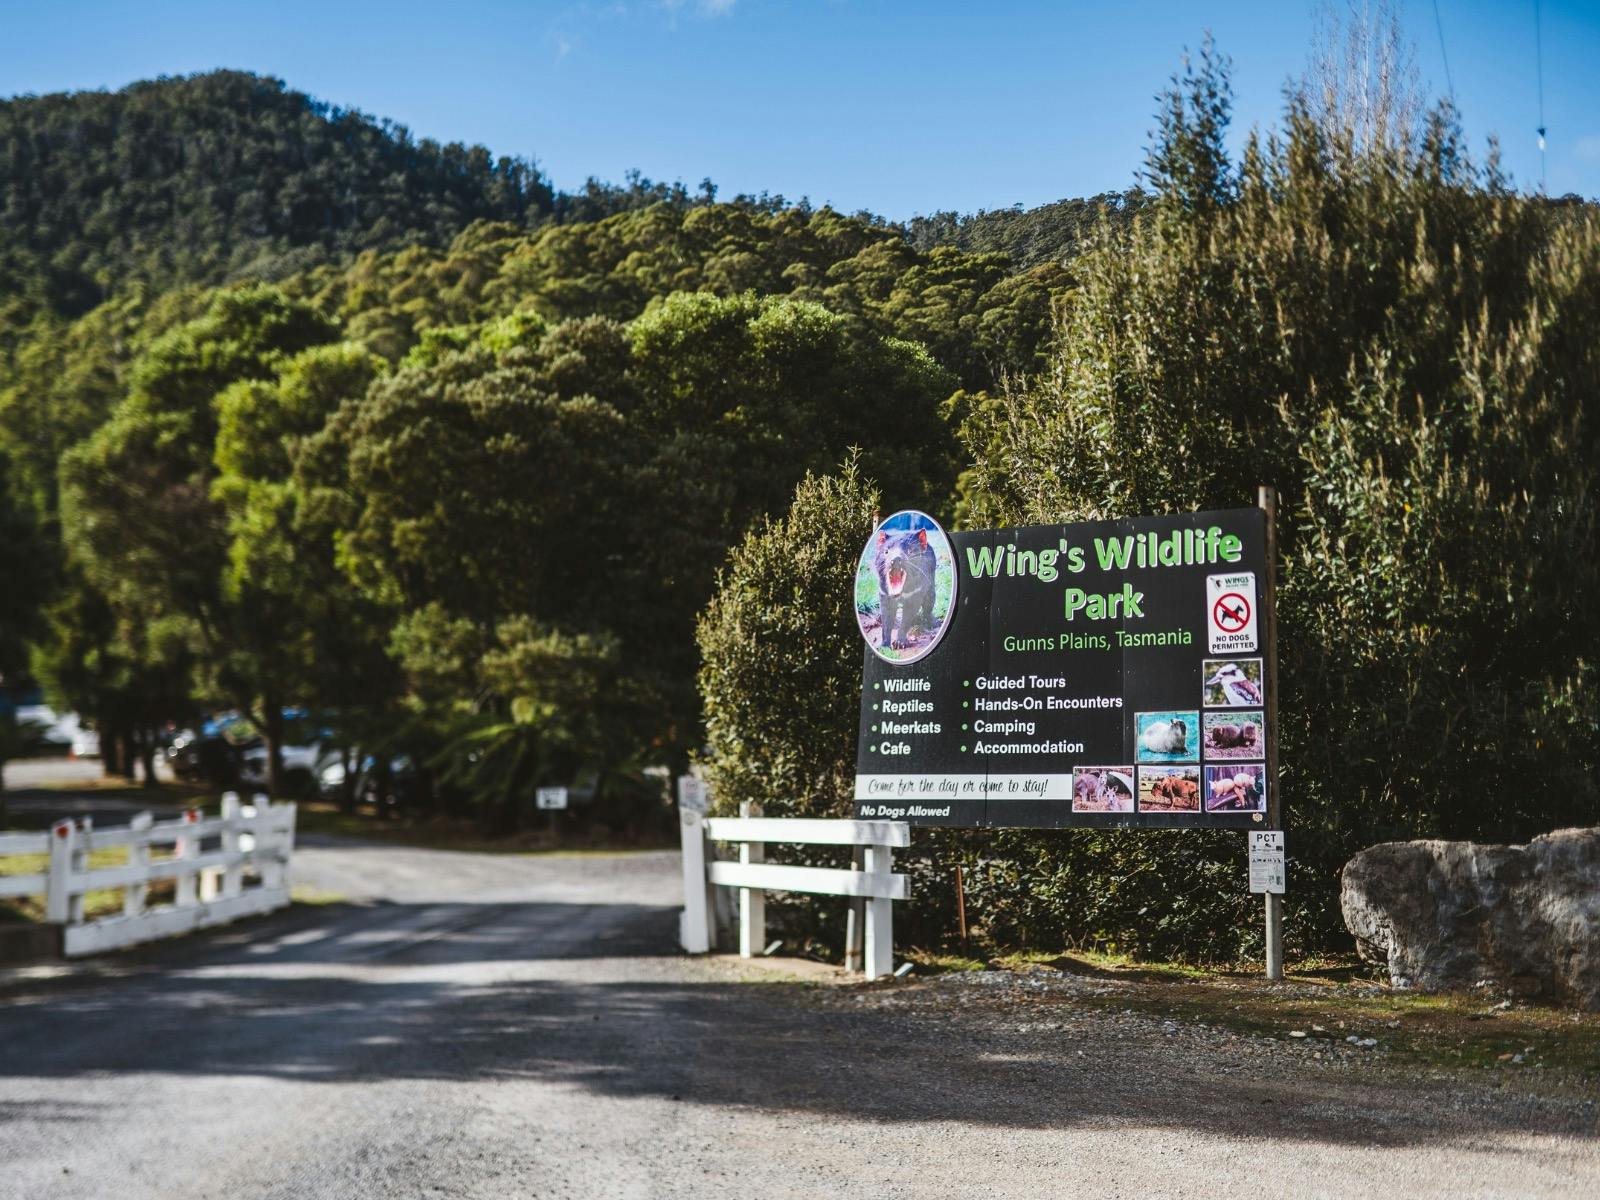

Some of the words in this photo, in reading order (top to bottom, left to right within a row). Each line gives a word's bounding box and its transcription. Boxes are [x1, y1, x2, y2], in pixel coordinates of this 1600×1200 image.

[966, 539, 1085, 582] Wing's
[1094, 526, 1242, 571] Wildlife
[1065, 583, 1144, 620] Park
[1004, 636, 1054, 652] Gunns
[1060, 632, 1111, 650] Plains,
[1116, 629, 1192, 647] Tasmania
[1212, 642, 1254, 650] PERMITTED
[883, 679, 931, 692] Wildlife
[976, 677, 1025, 690] Guided
[1029, 677, 1066, 688] Tours
[882, 700, 934, 715] Reptiles
[975, 697, 1043, 711] Hands-On
[1047, 696, 1123, 709] Encounters
[881, 722, 941, 734] Meerkats
[974, 720, 1036, 735] Camping
[880, 742, 911, 754] Cafe
[974, 741, 1084, 754] Accommodation
[868, 779, 895, 793] Come
[899, 780, 914, 795] for
[919, 779, 934, 792] the
[939, 779, 959, 796] day
[963, 781, 974, 792] or
[979, 781, 1004, 793] come
[1008, 780, 1018, 792] to
[1023, 779, 1048, 797] stay!
[861, 806, 876, 816] No
[878, 806, 905, 818] Dogs
[907, 807, 950, 817] Allowed
[1257, 834, 1276, 842] PCT
